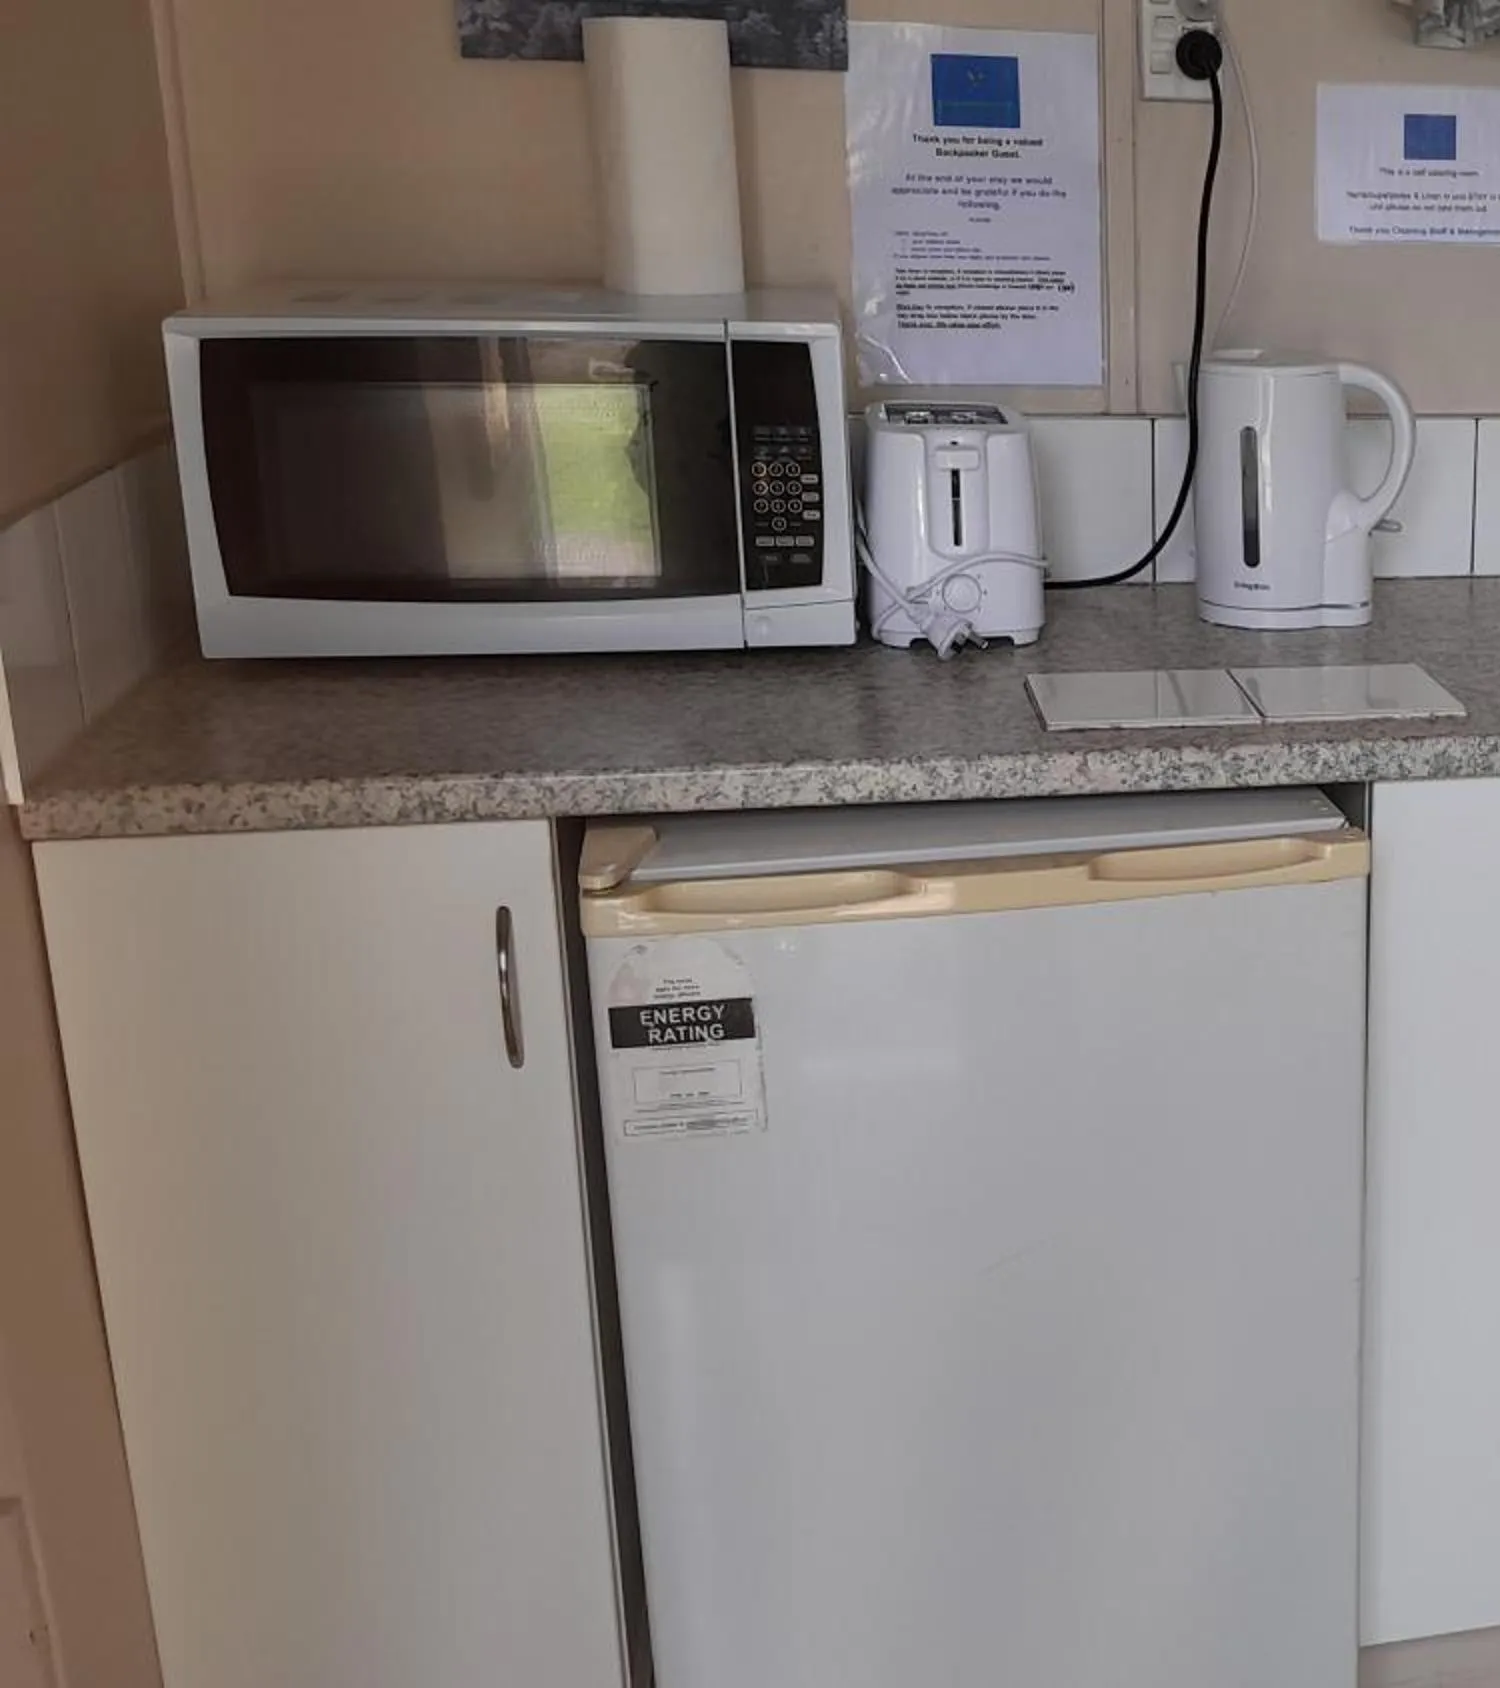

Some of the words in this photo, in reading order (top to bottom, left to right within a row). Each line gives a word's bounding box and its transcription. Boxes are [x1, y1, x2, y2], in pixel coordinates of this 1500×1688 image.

[913, 133, 940, 143] Thank
[942, 137, 960, 146] you
[935, 147, 989, 157] Backpacker
[942, 187, 958, 195] and
[640, 1003, 727, 1027] ENERGY
[648, 1023, 725, 1044] RATING
